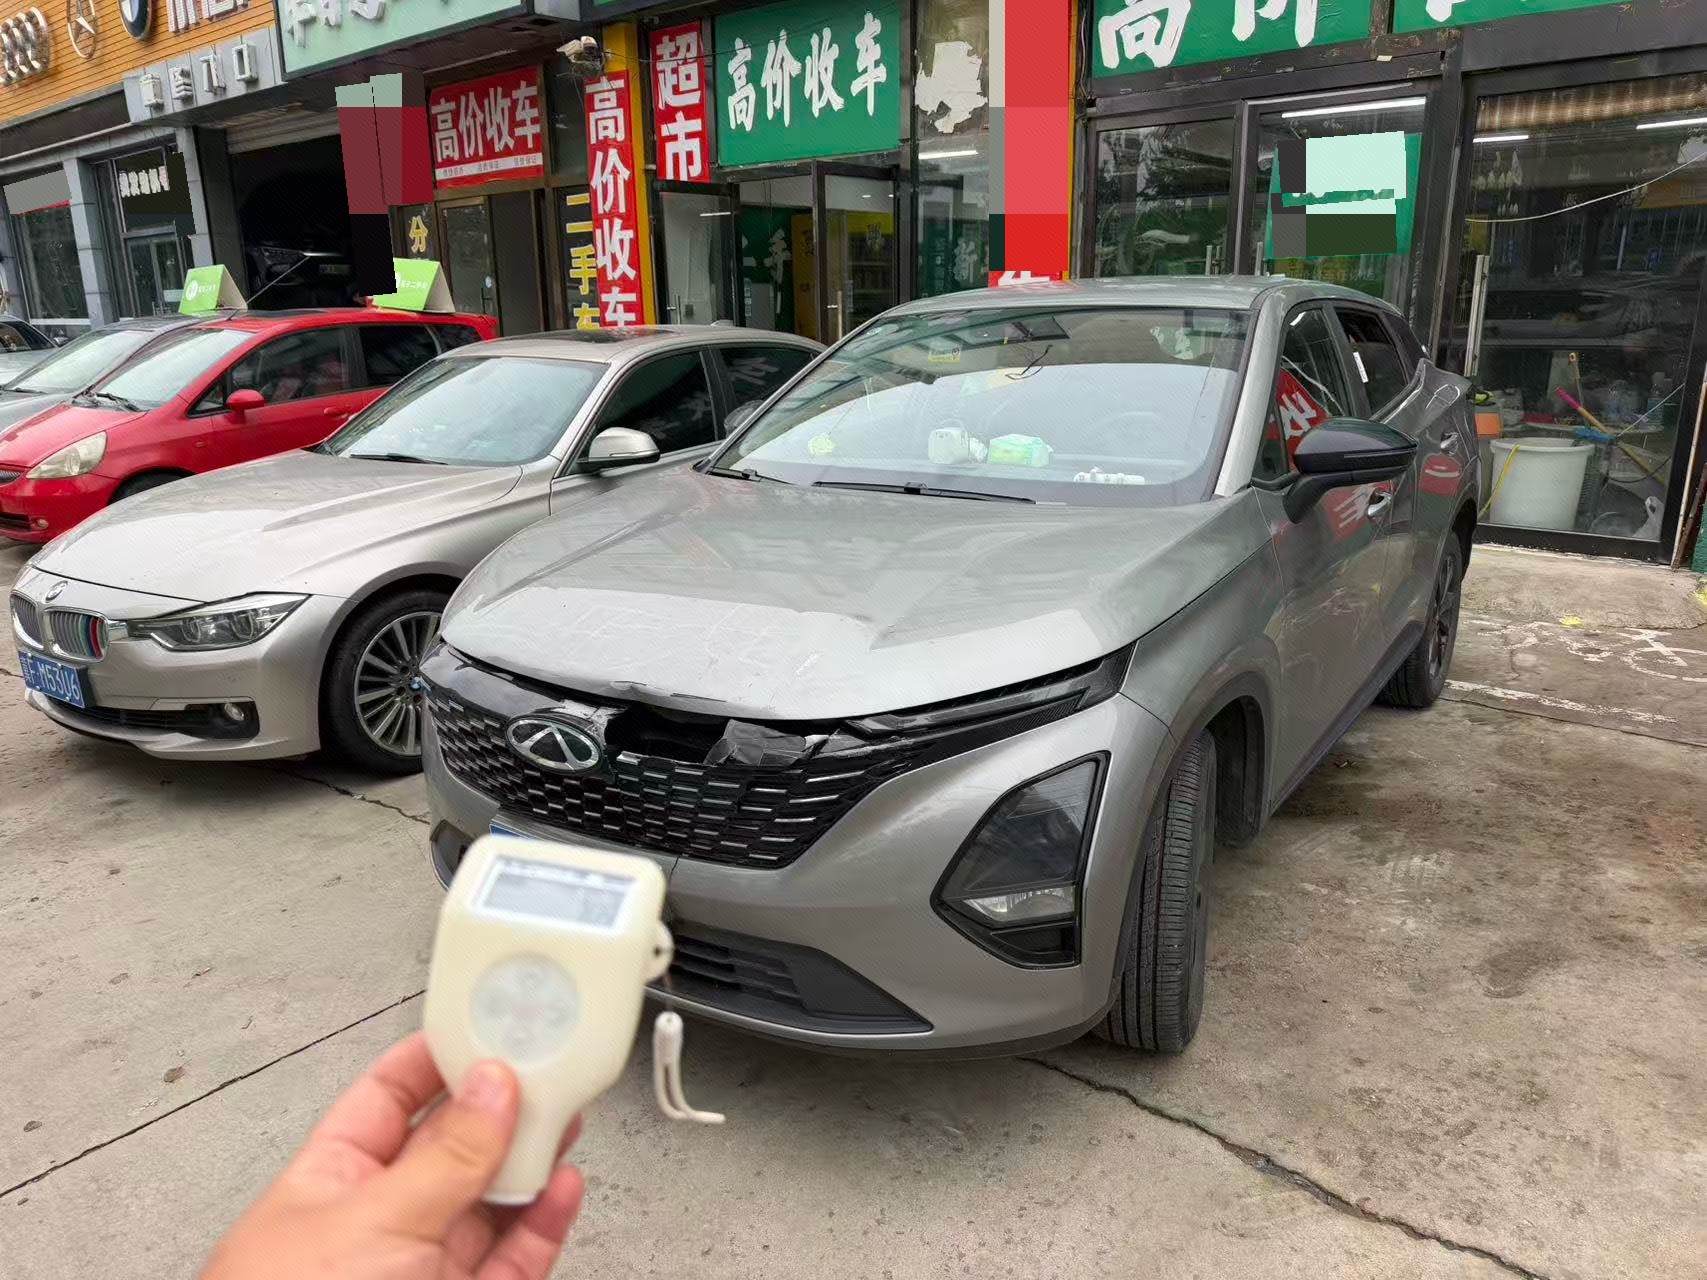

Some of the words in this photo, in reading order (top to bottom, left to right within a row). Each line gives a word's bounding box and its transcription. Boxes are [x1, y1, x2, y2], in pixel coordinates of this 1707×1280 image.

[431, 80, 541, 163] 高价收车
[656, 31, 702, 182] 超市
[728, 11, 887, 131] 高价收车
[408, 214, 429, 254] 分
